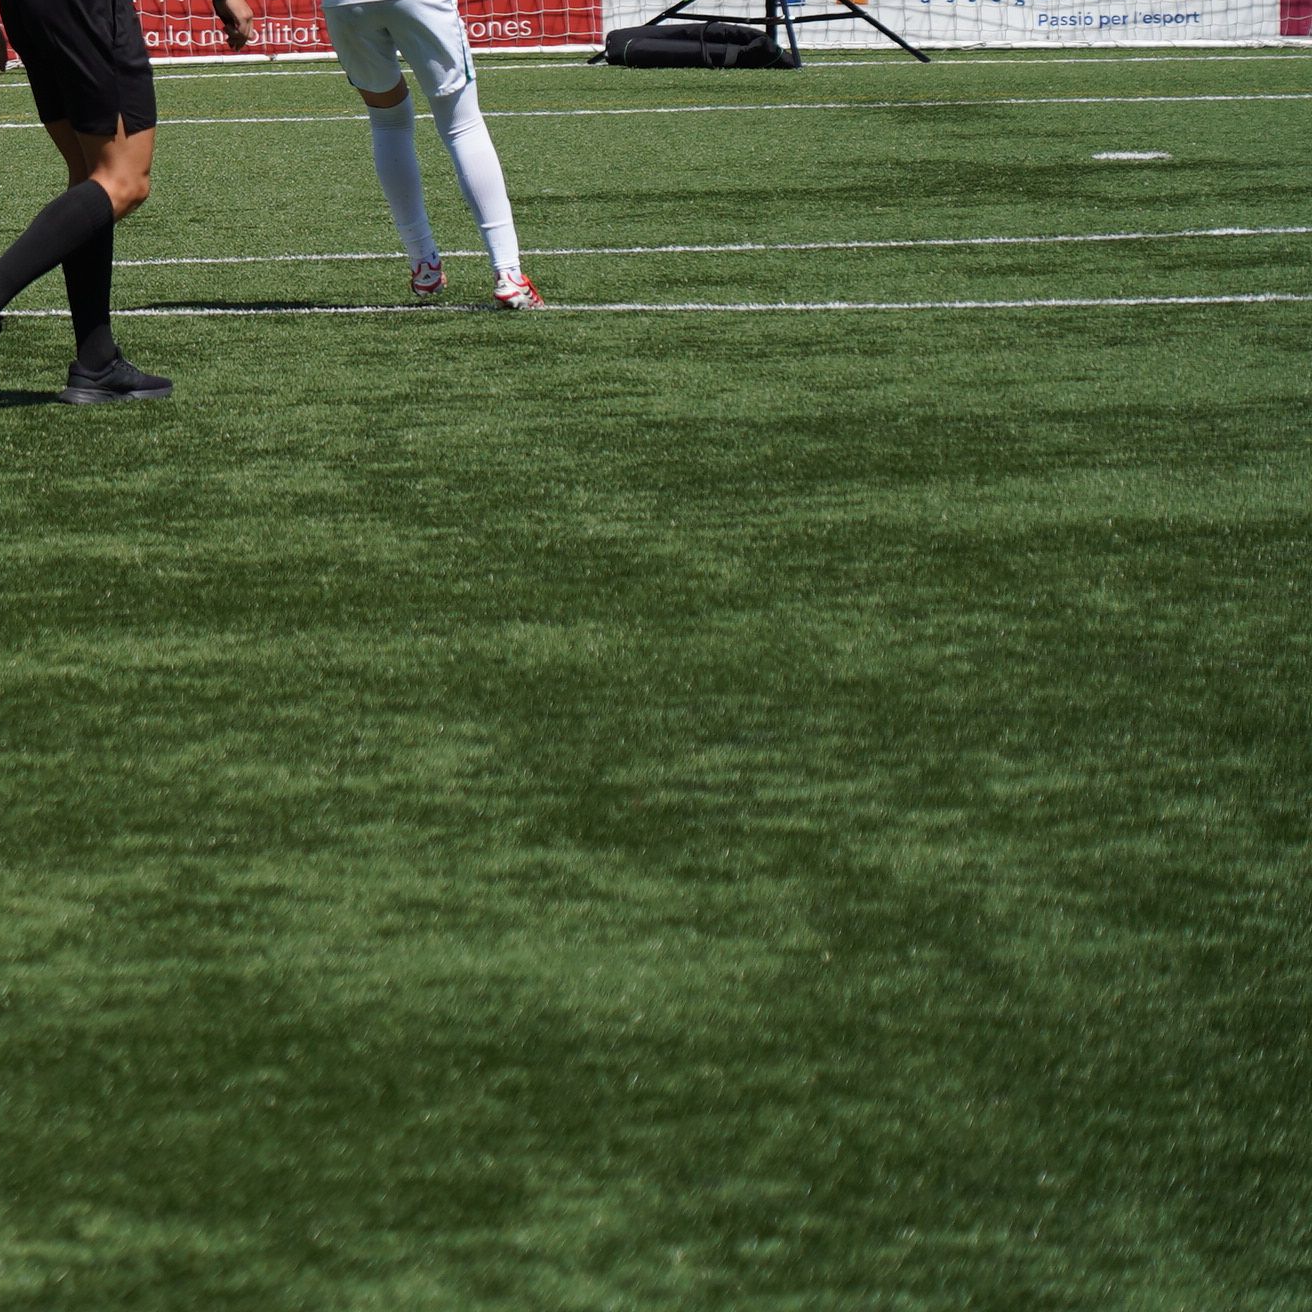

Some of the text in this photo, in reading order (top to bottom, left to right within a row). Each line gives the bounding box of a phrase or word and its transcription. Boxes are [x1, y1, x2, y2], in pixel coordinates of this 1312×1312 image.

[1037, 10, 1200, 29] Passió per l'esport
[169, 25, 192, 45] la
